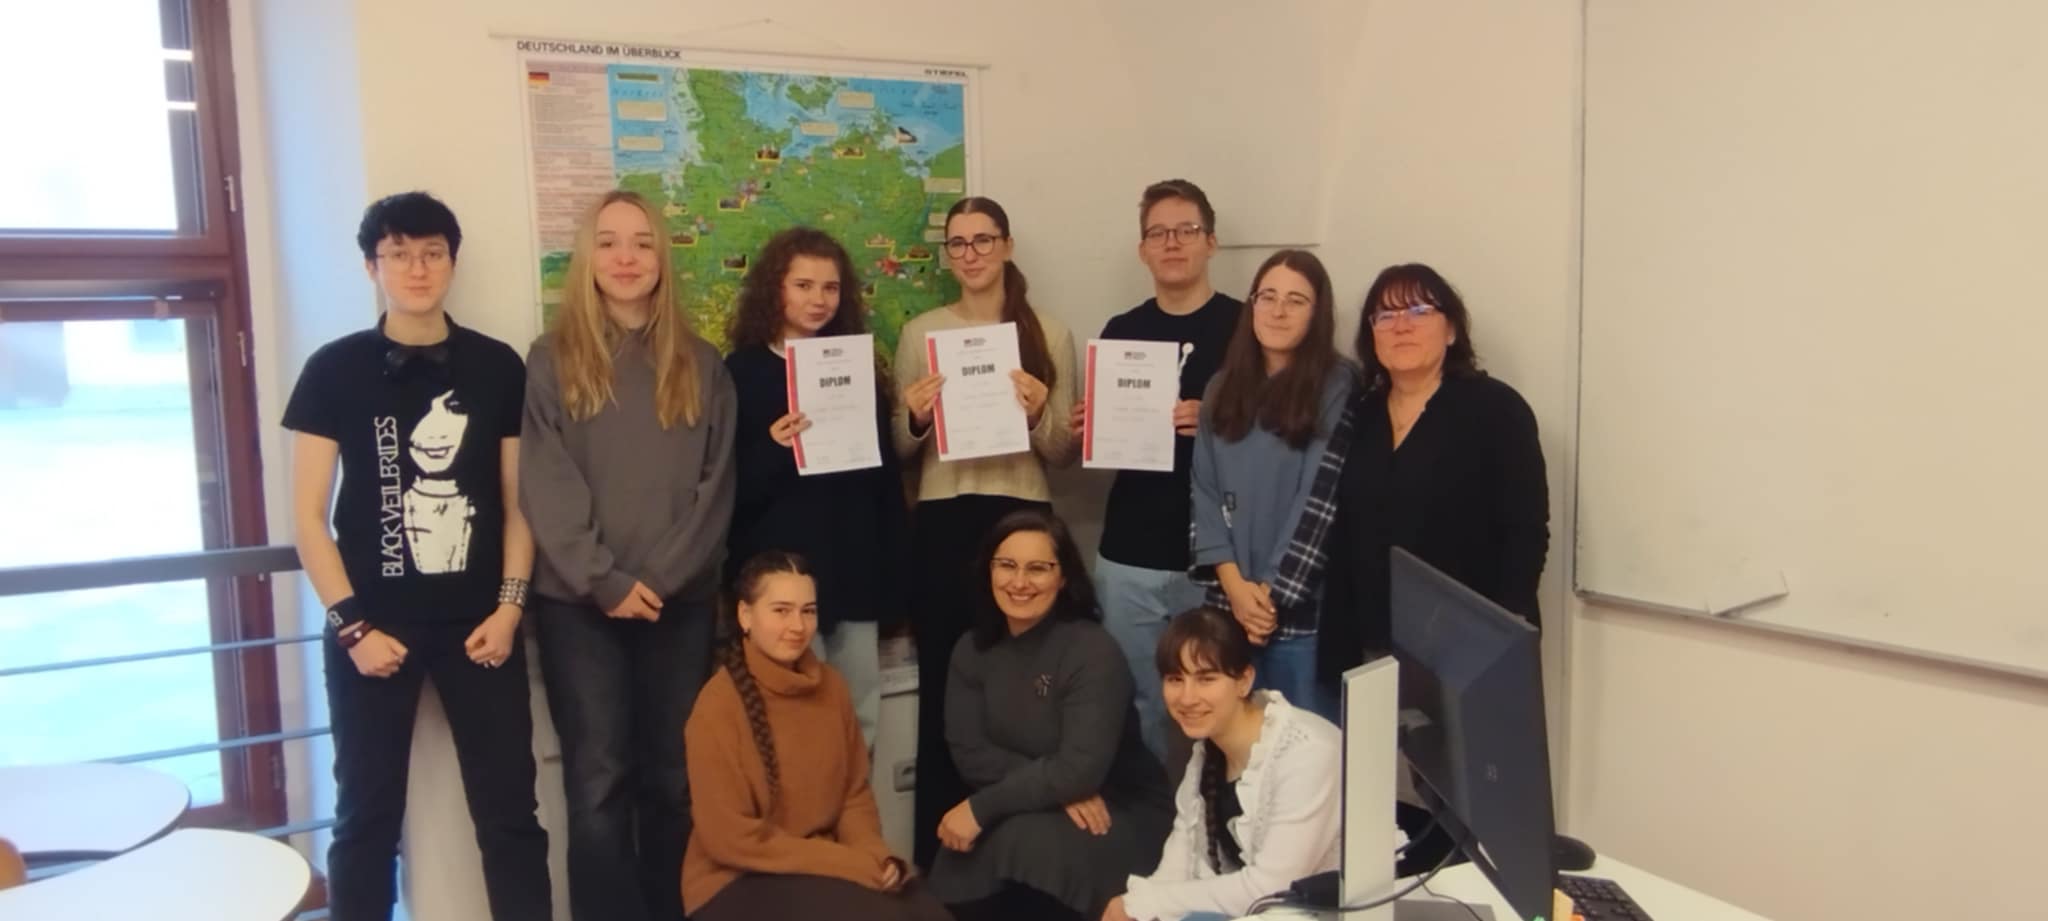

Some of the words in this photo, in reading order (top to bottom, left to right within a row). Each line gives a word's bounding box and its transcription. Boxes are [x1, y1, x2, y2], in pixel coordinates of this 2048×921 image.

[516, 40, 602, 56] DEUTSCHLAND
[606, 45, 620, 57] IM
[622, 44, 682, 60] ÜBERBLICK
[961, 363, 996, 376] DIPLOM
[819, 375, 851, 389] DIPLOM
[1117, 377, 1151, 390] DIPLOM
[374, 415, 399, 478] BRIDES
[381, 477, 402, 523] VEIL
[381, 522, 404, 577] BLACK
